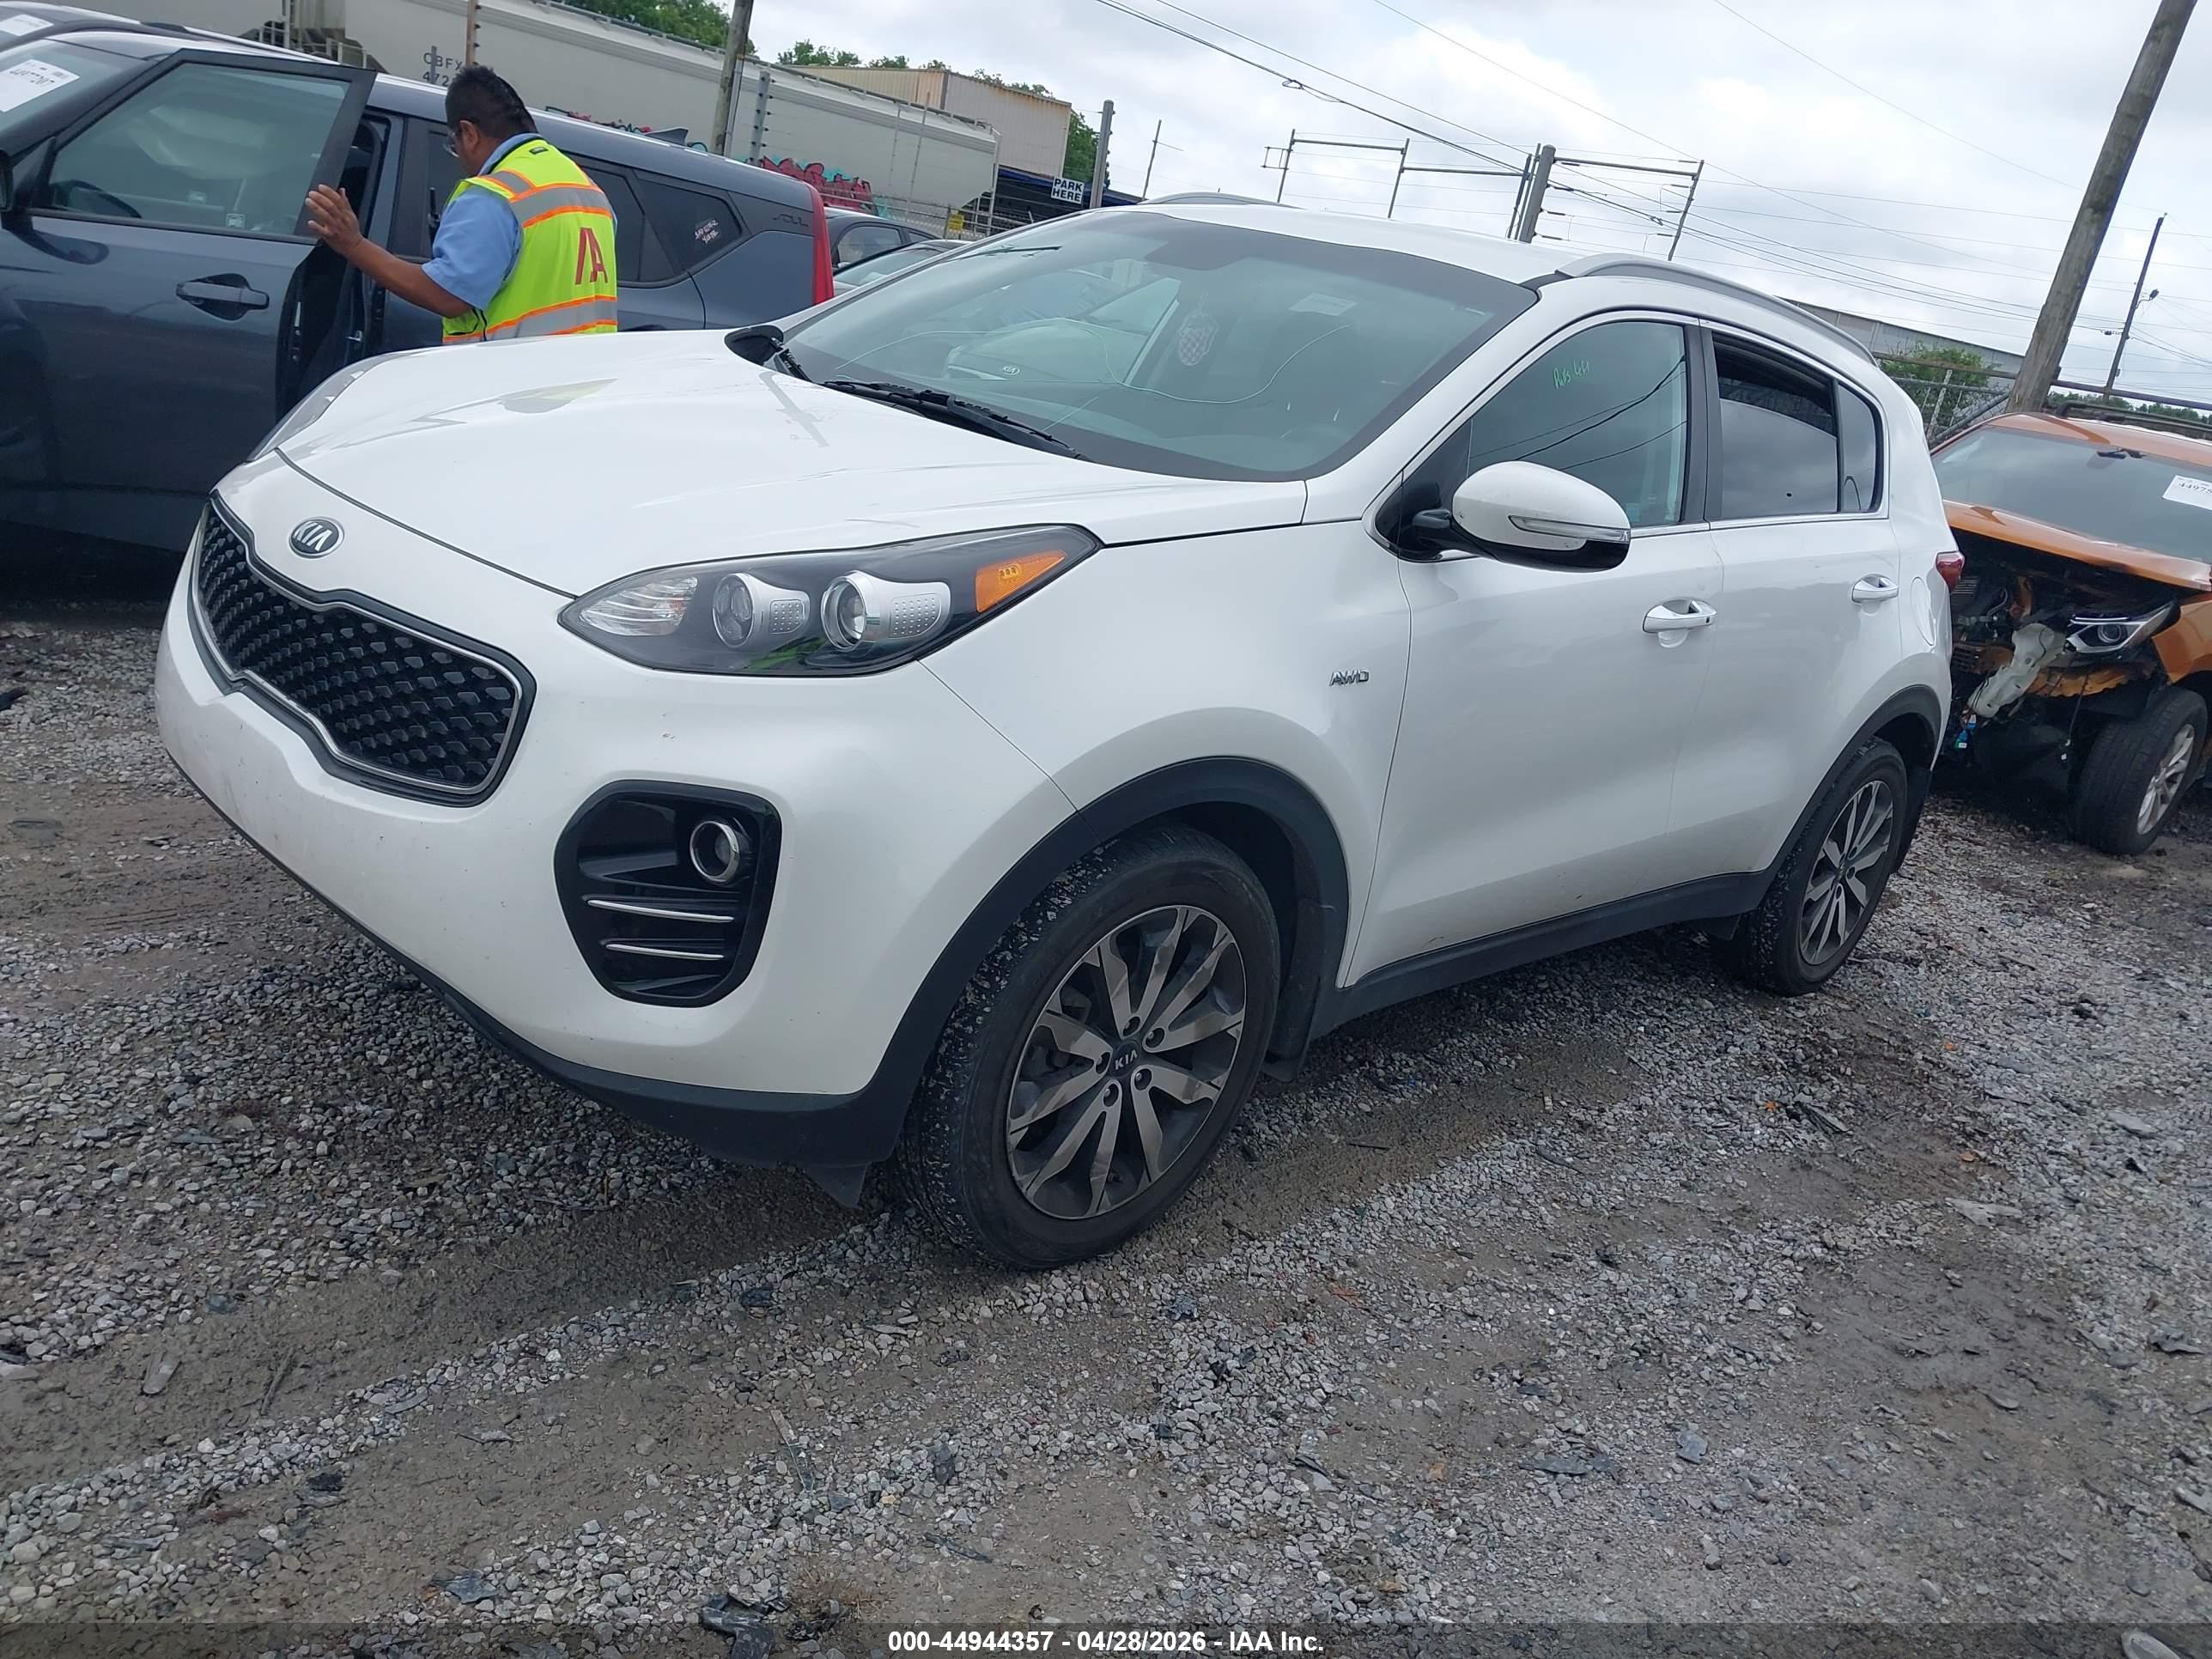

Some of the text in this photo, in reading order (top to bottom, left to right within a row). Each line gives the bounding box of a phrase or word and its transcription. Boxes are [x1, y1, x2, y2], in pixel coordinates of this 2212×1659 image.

[1054, 178, 1083, 192] PARK
[1052, 187, 1082, 202] HERE
[293, 520, 333, 551] KIA
[1328, 669, 1370, 687] AWD
[1115, 1048, 1139, 1071] KIA
